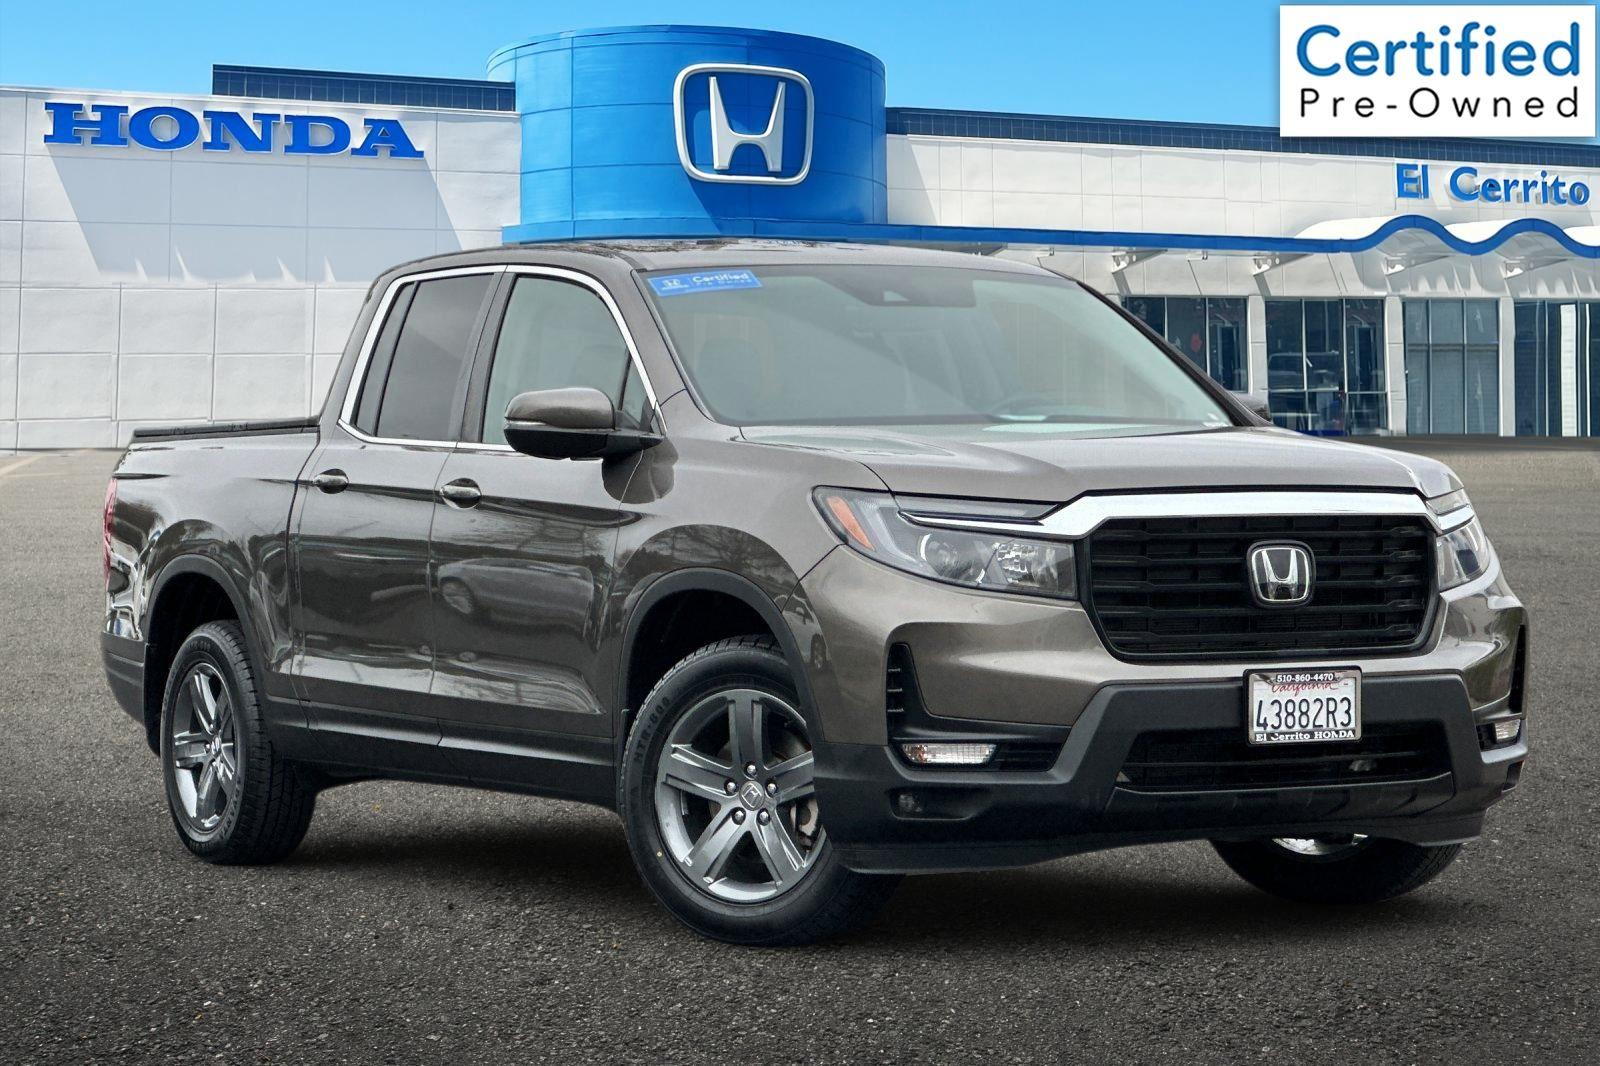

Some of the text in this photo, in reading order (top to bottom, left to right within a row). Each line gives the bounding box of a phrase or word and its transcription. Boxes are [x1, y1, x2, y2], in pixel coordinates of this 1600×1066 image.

[43, 101, 425, 159] HONDA
[1396, 163, 1591, 206] El Cerrito
[1277, 673, 1334, 682] 510-860-4470
[1256, 697, 1352, 730] 43882R3
[1255, 733, 1267, 742] El
[1314, 730, 1355, 740] HONDA
